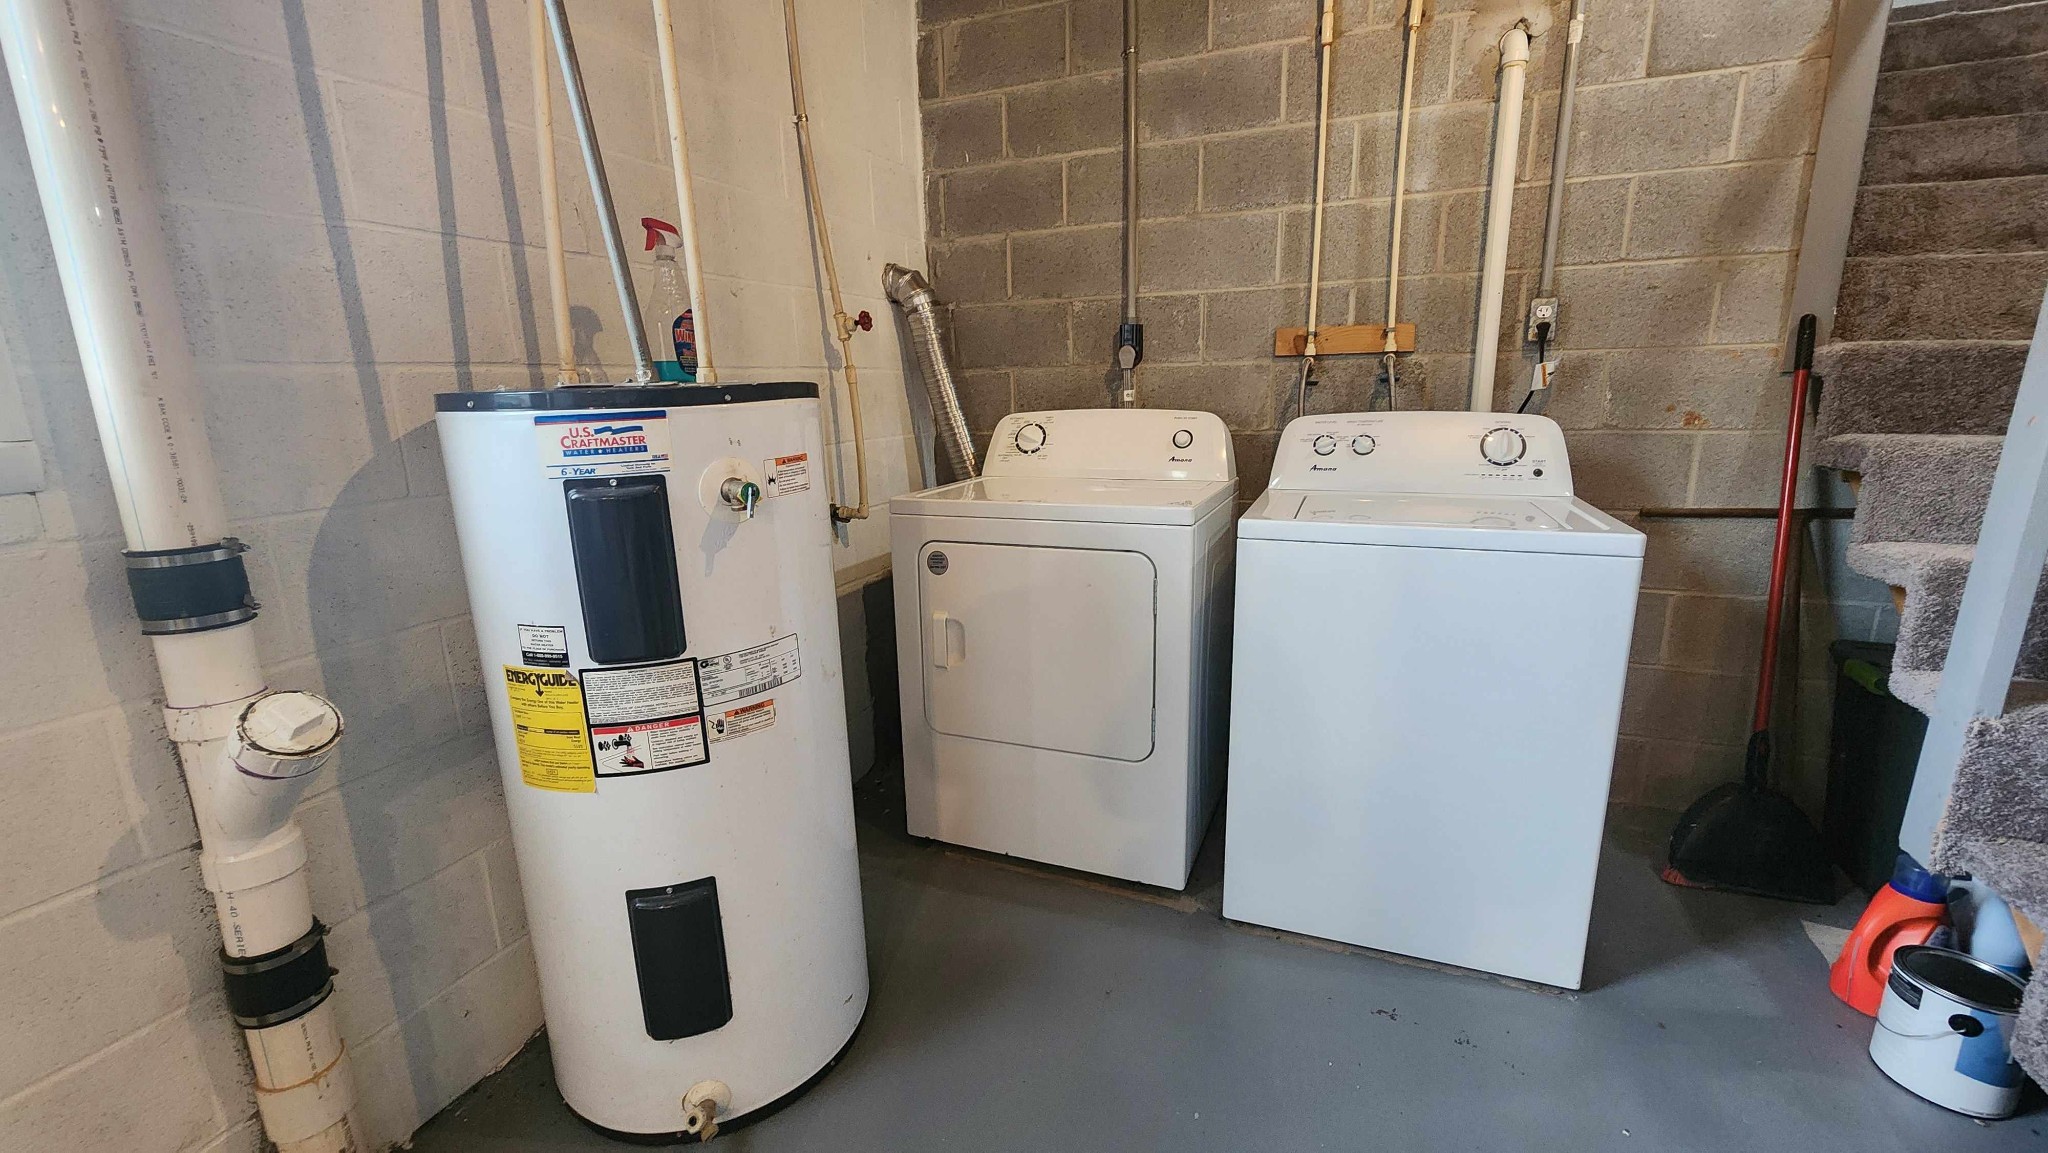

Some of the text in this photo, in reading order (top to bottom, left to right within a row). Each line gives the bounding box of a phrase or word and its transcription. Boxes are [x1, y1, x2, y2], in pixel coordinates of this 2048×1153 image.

[569, 426, 594, 438] U.S.
[560, 436, 646, 449] CRAFTMASTER
[740, 702, 765, 714] WARNING
[635, 723, 670, 732] DANGER
